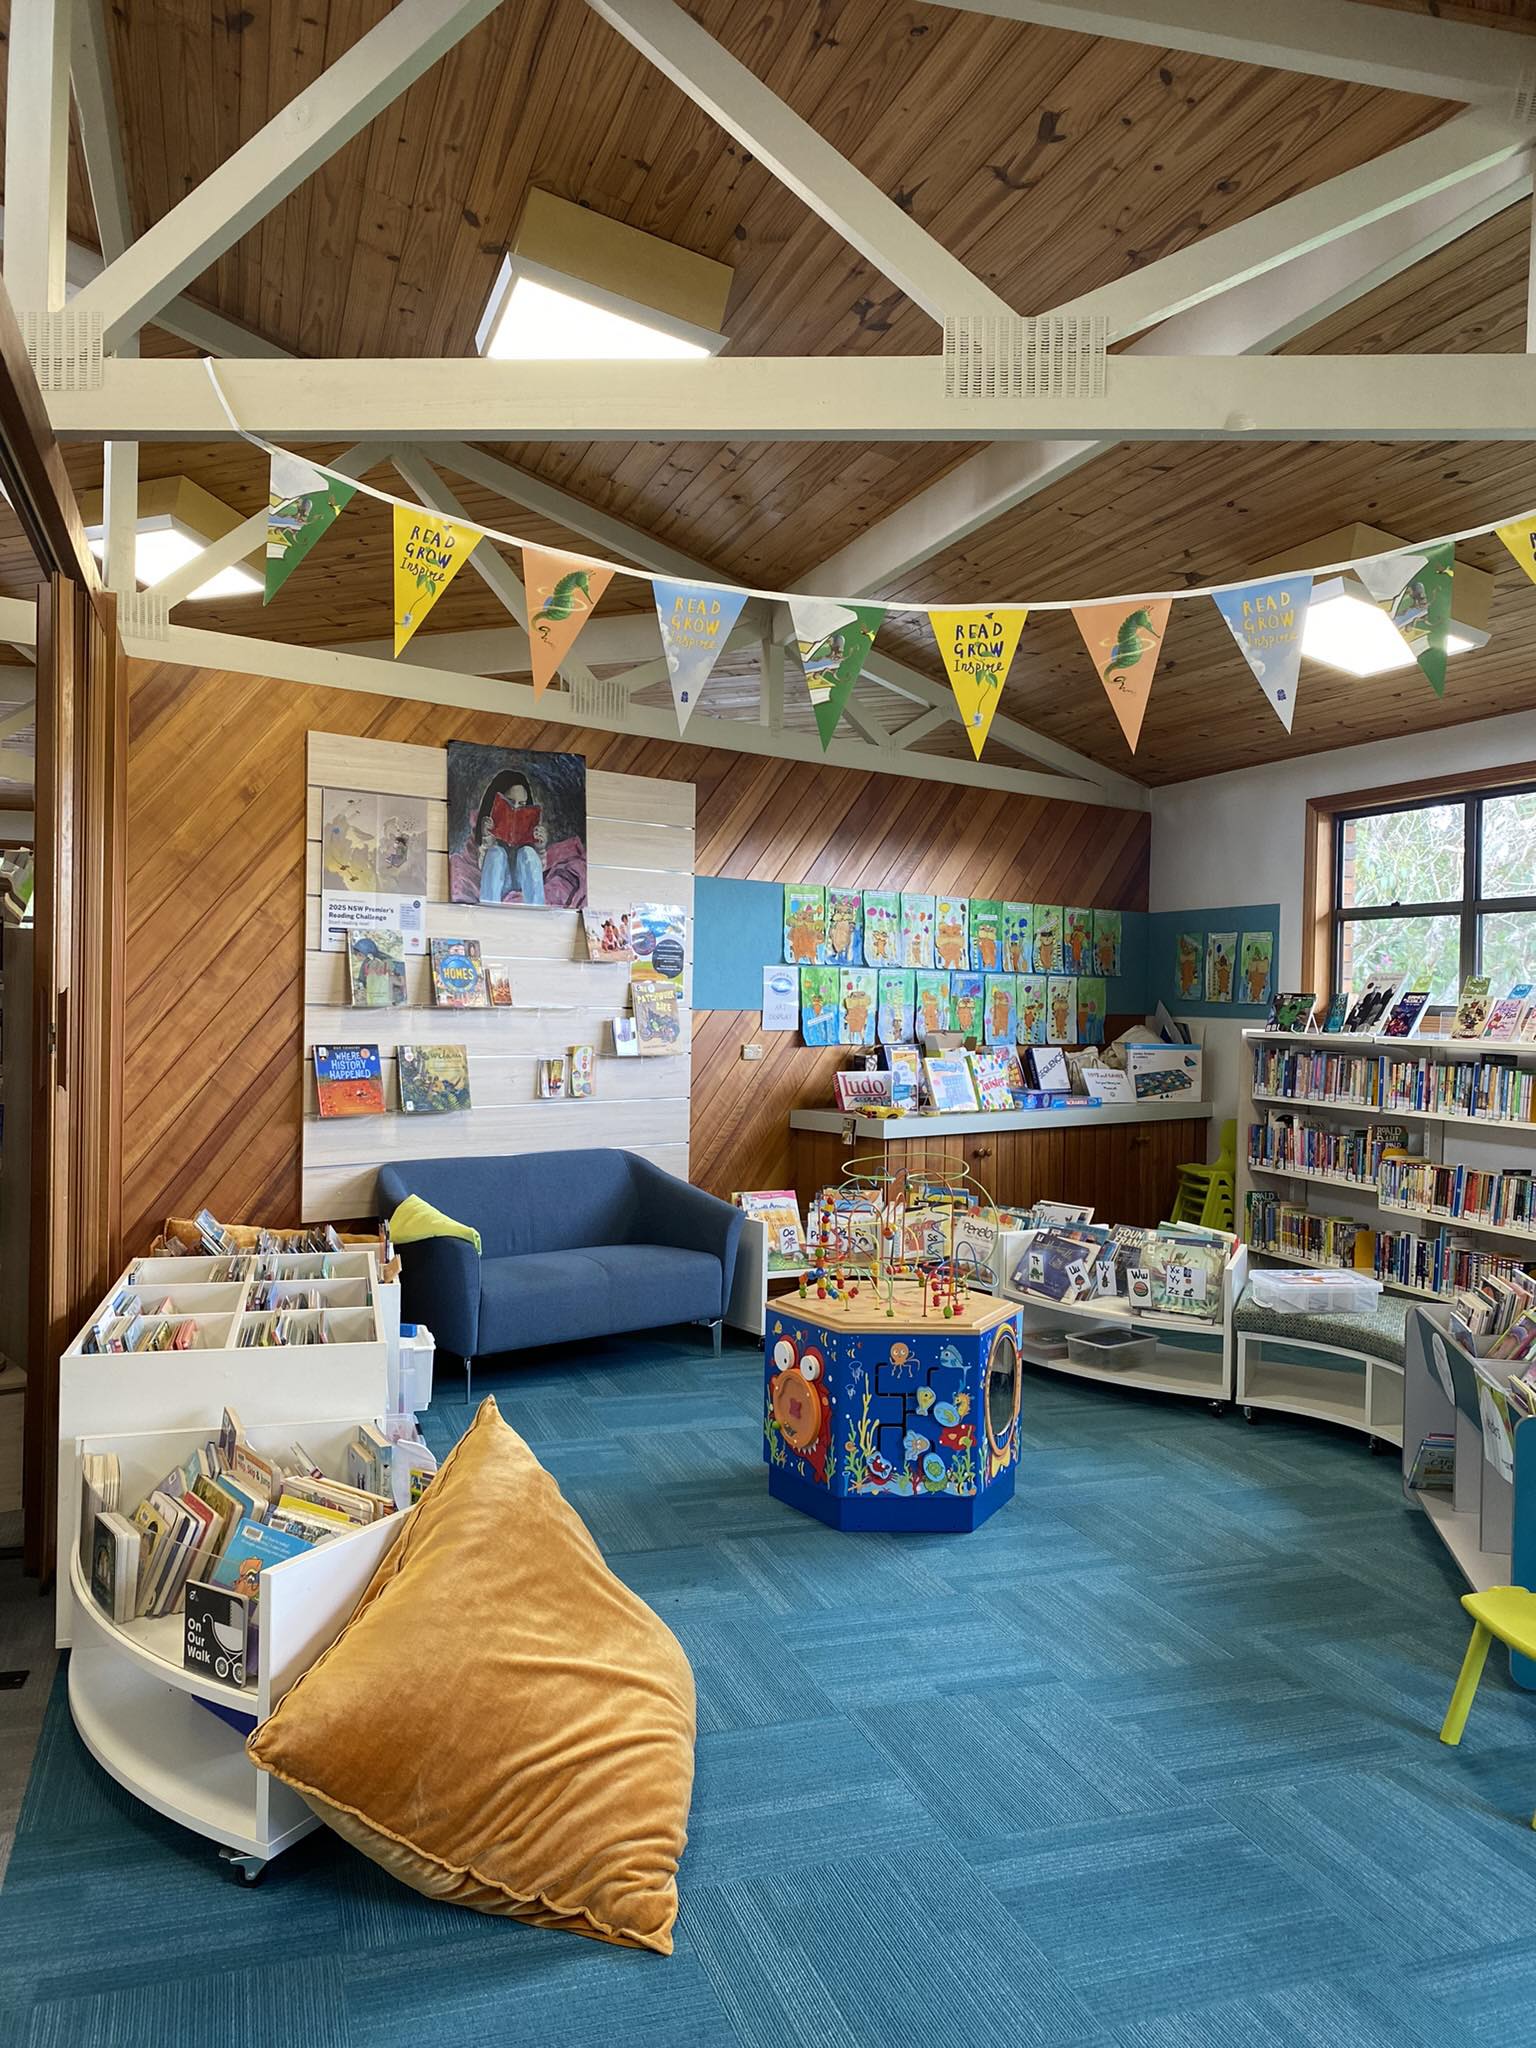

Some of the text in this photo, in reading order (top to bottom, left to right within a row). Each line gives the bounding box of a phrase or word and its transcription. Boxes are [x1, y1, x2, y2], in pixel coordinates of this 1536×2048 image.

[410, 526, 456, 548] READ
[405, 542, 453, 569] GROW
[400, 557, 445, 582] Inspire
[675, 596, 720, 616] READ
[1242, 592, 1290, 617] READ
[671, 615, 720, 636] GROW
[1244, 608, 1295, 634] GROW
[955, 622, 1003, 641] READ
[954, 641, 1004, 659] GROW
[953, 659, 1004, 675] Inspire
[328, 903, 347, 911] 2025
[364, 906, 394, 914] Premier's
[328, 912, 387, 921] Reading Challenge
[443, 967, 474, 980] HOMES
[335, 1051, 361, 1061] WHERE
[329, 1069, 371, 1080] HAPPENED
[840, 1074, 888, 1097] Ludo
[1376, 1126, 1402, 1136] ROALD
[1252, 1192, 1275, 1201] ROALD
[782, 1228, 795, 1237] Oo
[927, 1233, 938, 1242] Ss
[1068, 1264, 1081, 1275] Uu
[1131, 1269, 1149, 1280] Ww
[1169, 1266, 1181, 1274] Xx
[1169, 1275, 1181, 1285] Yy
[187, 1617, 202, 1633] On
[187, 1631, 205, 1647] Our
[187, 1644, 211, 1664] Walk
